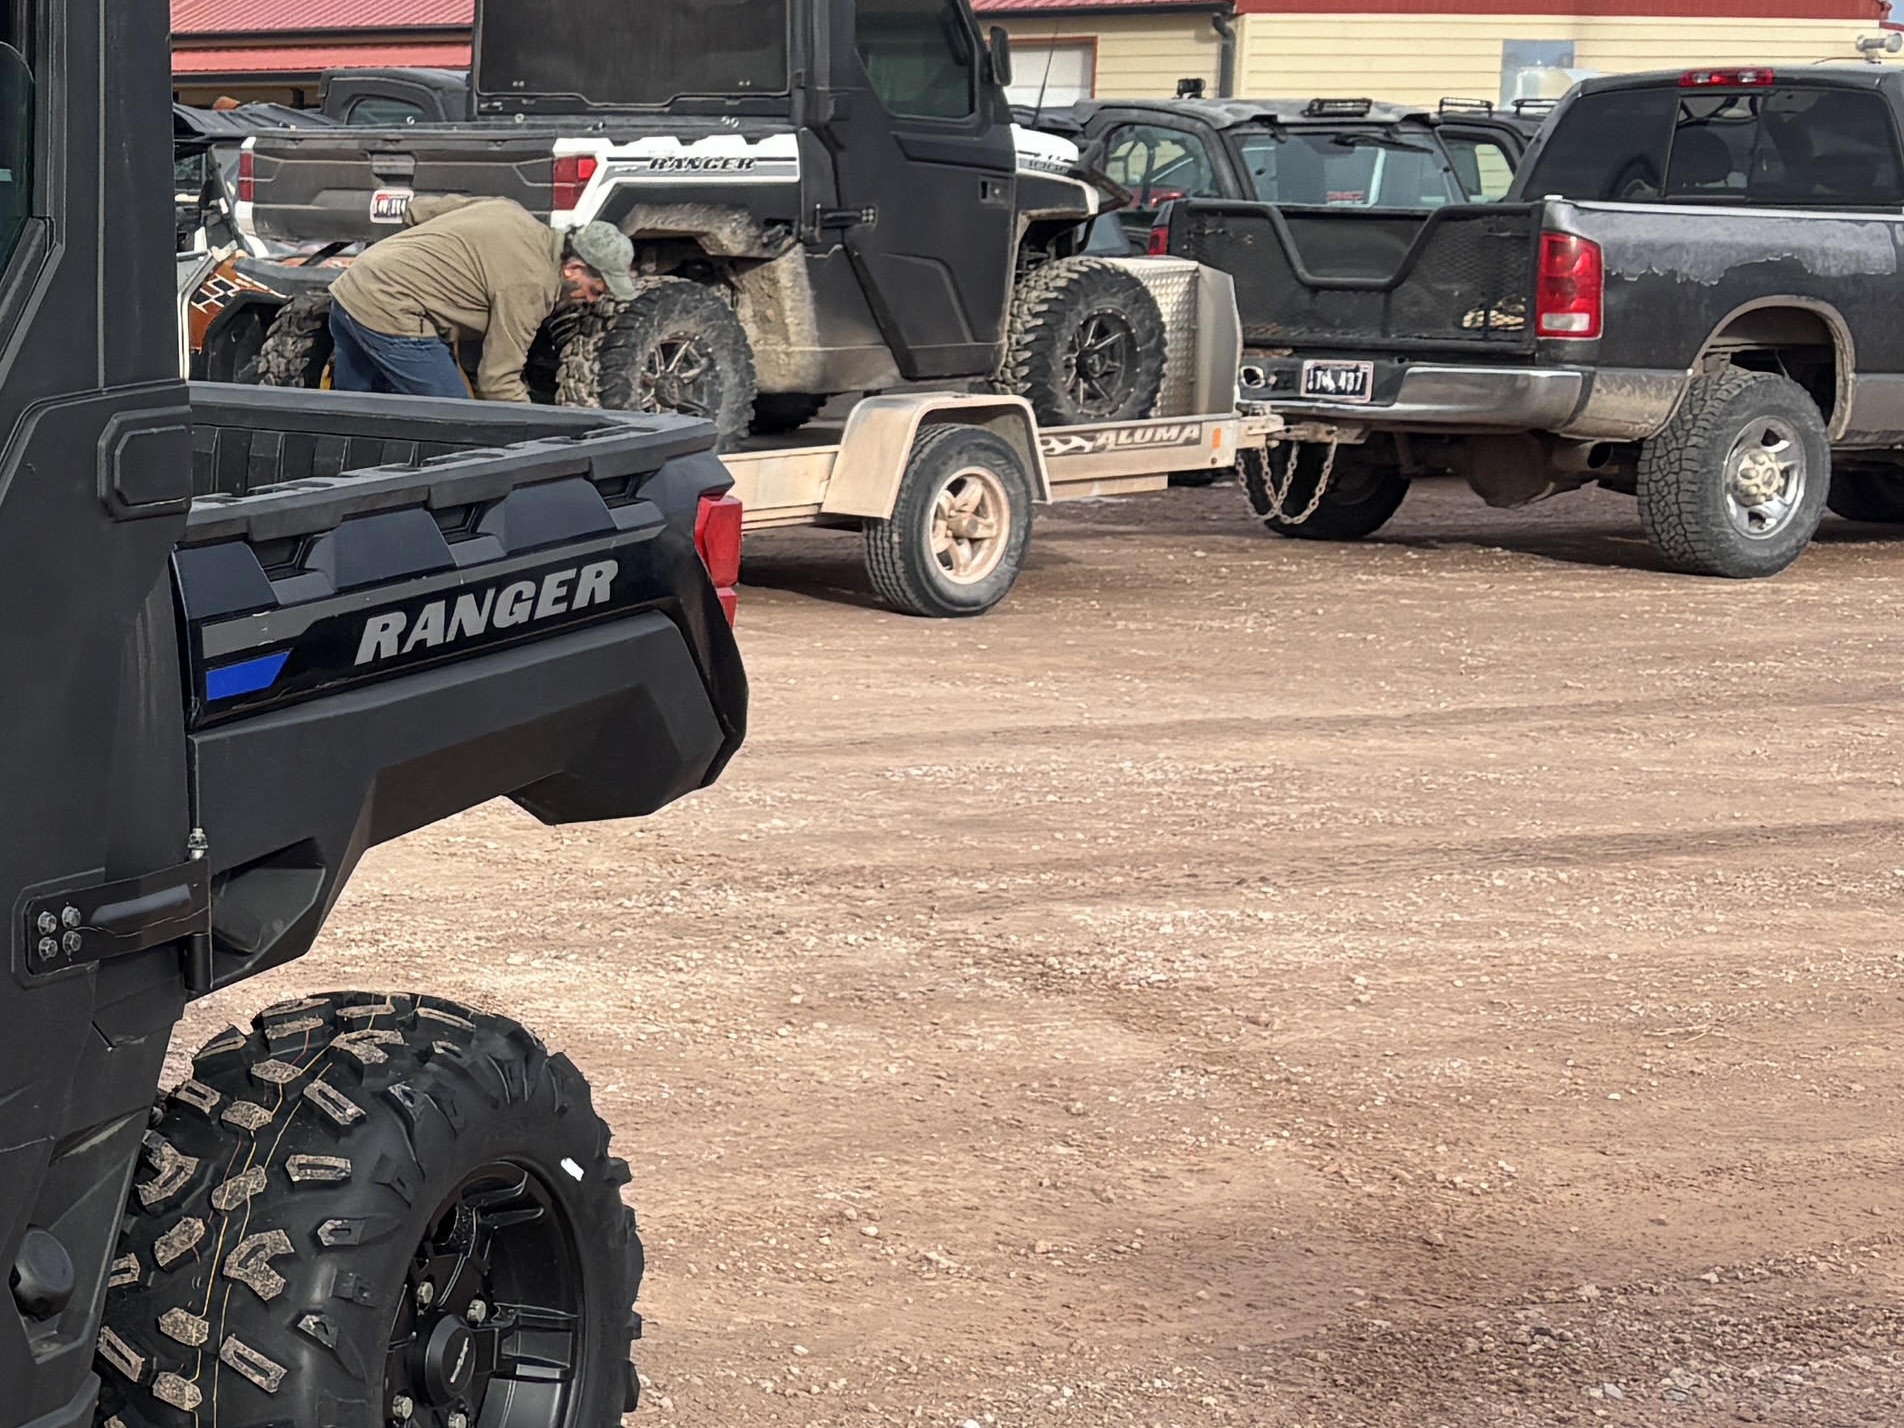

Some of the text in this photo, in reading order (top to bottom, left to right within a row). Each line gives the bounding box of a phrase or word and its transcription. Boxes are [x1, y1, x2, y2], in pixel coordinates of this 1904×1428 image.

[647, 156, 757, 172] RANGER
[1093, 424, 1201, 450] ALUMA
[353, 559, 619, 667] RANGER
